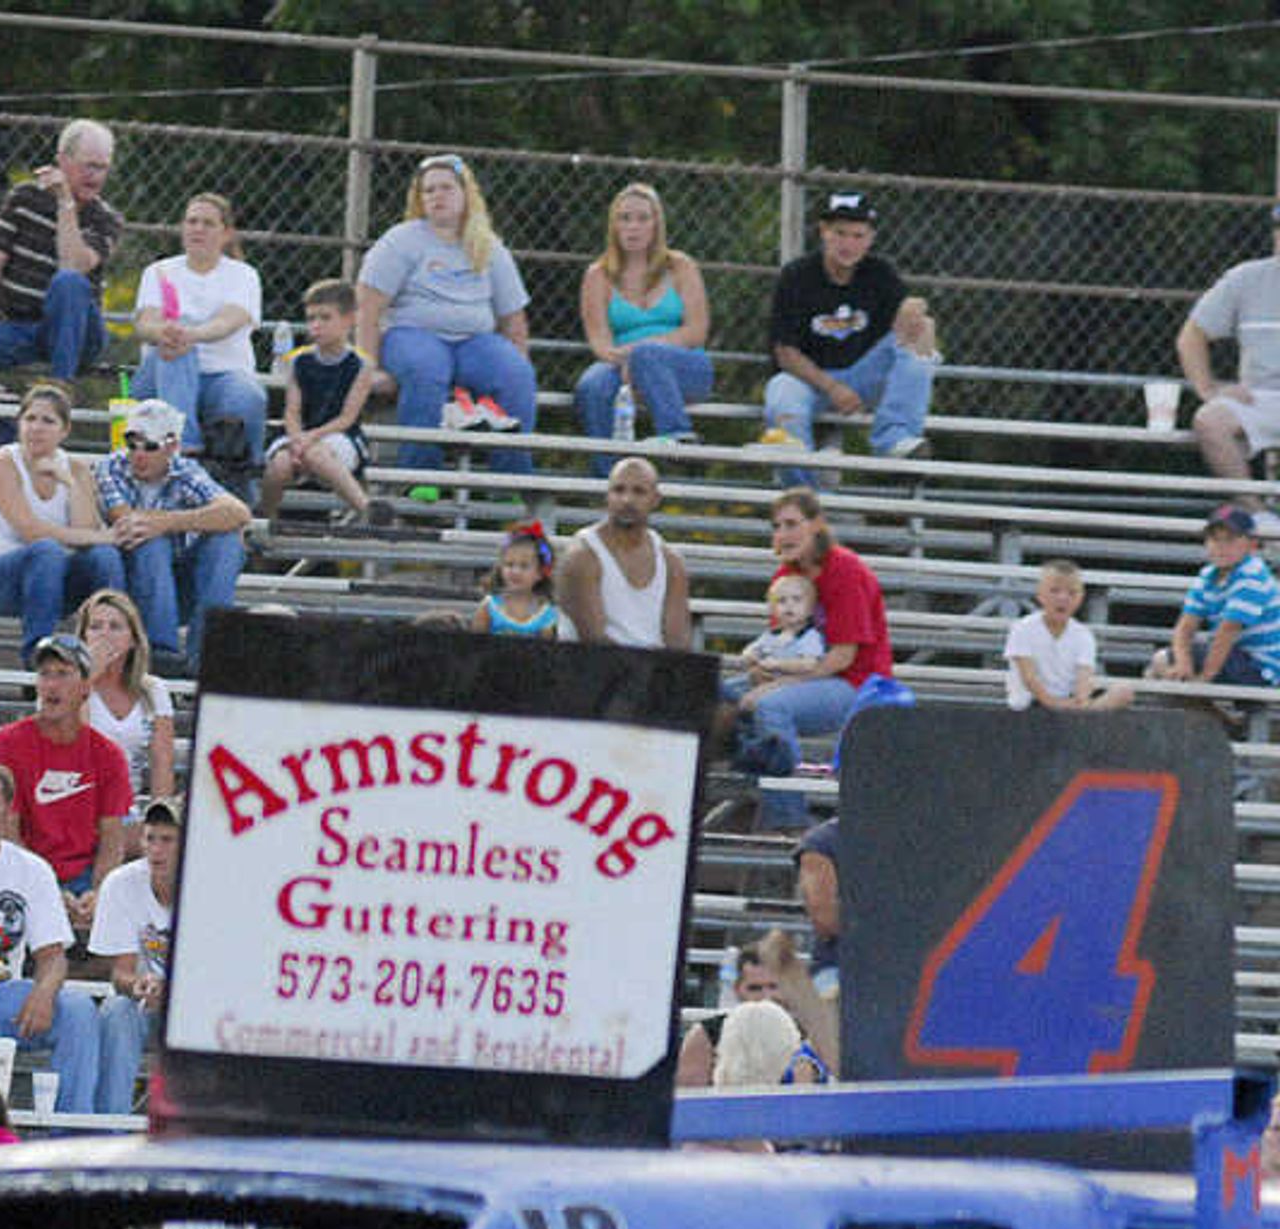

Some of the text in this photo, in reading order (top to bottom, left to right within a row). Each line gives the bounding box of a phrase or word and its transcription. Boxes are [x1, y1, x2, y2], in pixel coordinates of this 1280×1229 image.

[208, 722, 676, 879] Armstrong
[316, 806, 560, 883] Seamless
[275, 876, 570, 959] Guttering
[904, 771, 1181, 1080] 4
